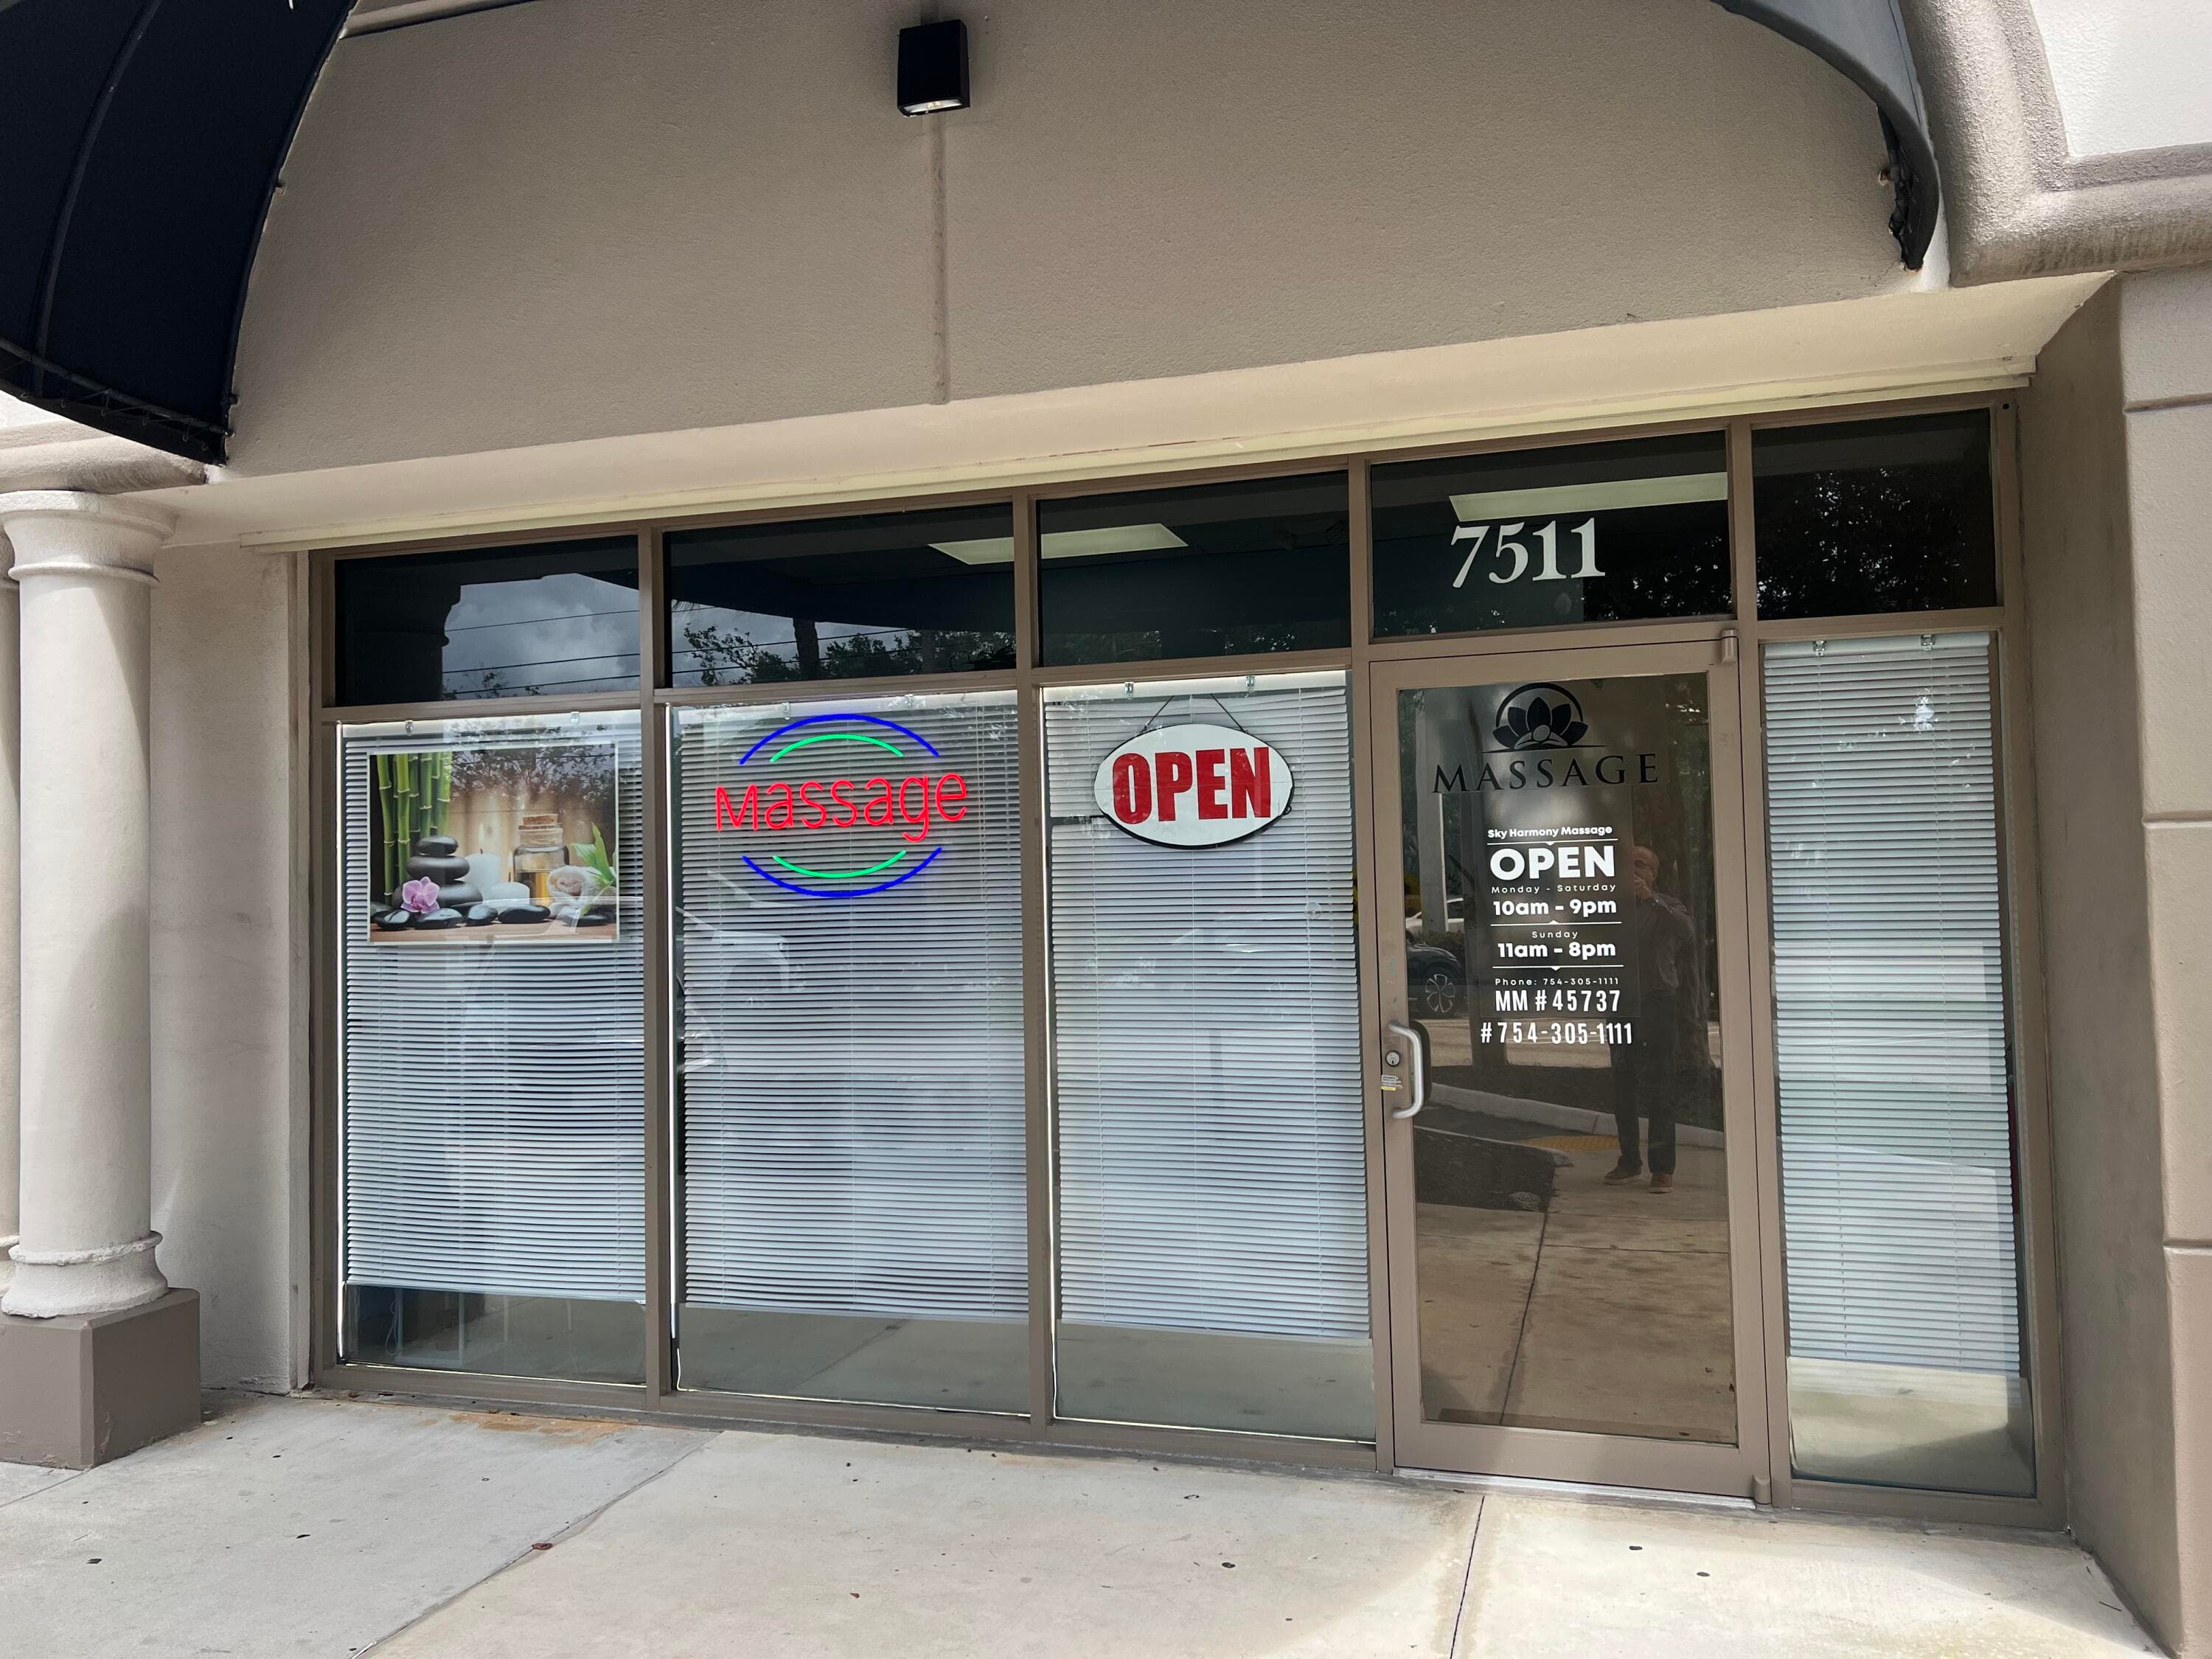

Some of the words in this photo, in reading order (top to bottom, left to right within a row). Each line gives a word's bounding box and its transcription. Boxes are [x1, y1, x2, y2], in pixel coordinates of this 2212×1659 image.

[1451, 518, 1606, 588] 7511
[1432, 753, 1658, 794] MASSAGE
[1112, 746, 1271, 824] OPEN
[714, 772, 967, 843] Massage
[1487, 830, 1507, 839] Sky
[1509, 827, 1559, 838] Harmony
[1561, 826, 1613, 836] Massage
[1490, 845, 1615, 880] OPEN
[1491, 886, 1540, 894] Monday
[1557, 883, 1616, 892] Saturday
[1493, 900, 1549, 916] 10am
[1569, 899, 1616, 917] 9pm
[1531, 931, 1579, 939] Sunday
[1498, 942, 1548, 958] 11am
[1568, 942, 1616, 960] 8pm
[1543, 978, 1619, 986] 754-305-1111
[1495, 990, 1528, 1012] MM
[1551, 989, 1621, 1012] 45737
[1497, 1022, 1632, 1044] 754-305-1111
